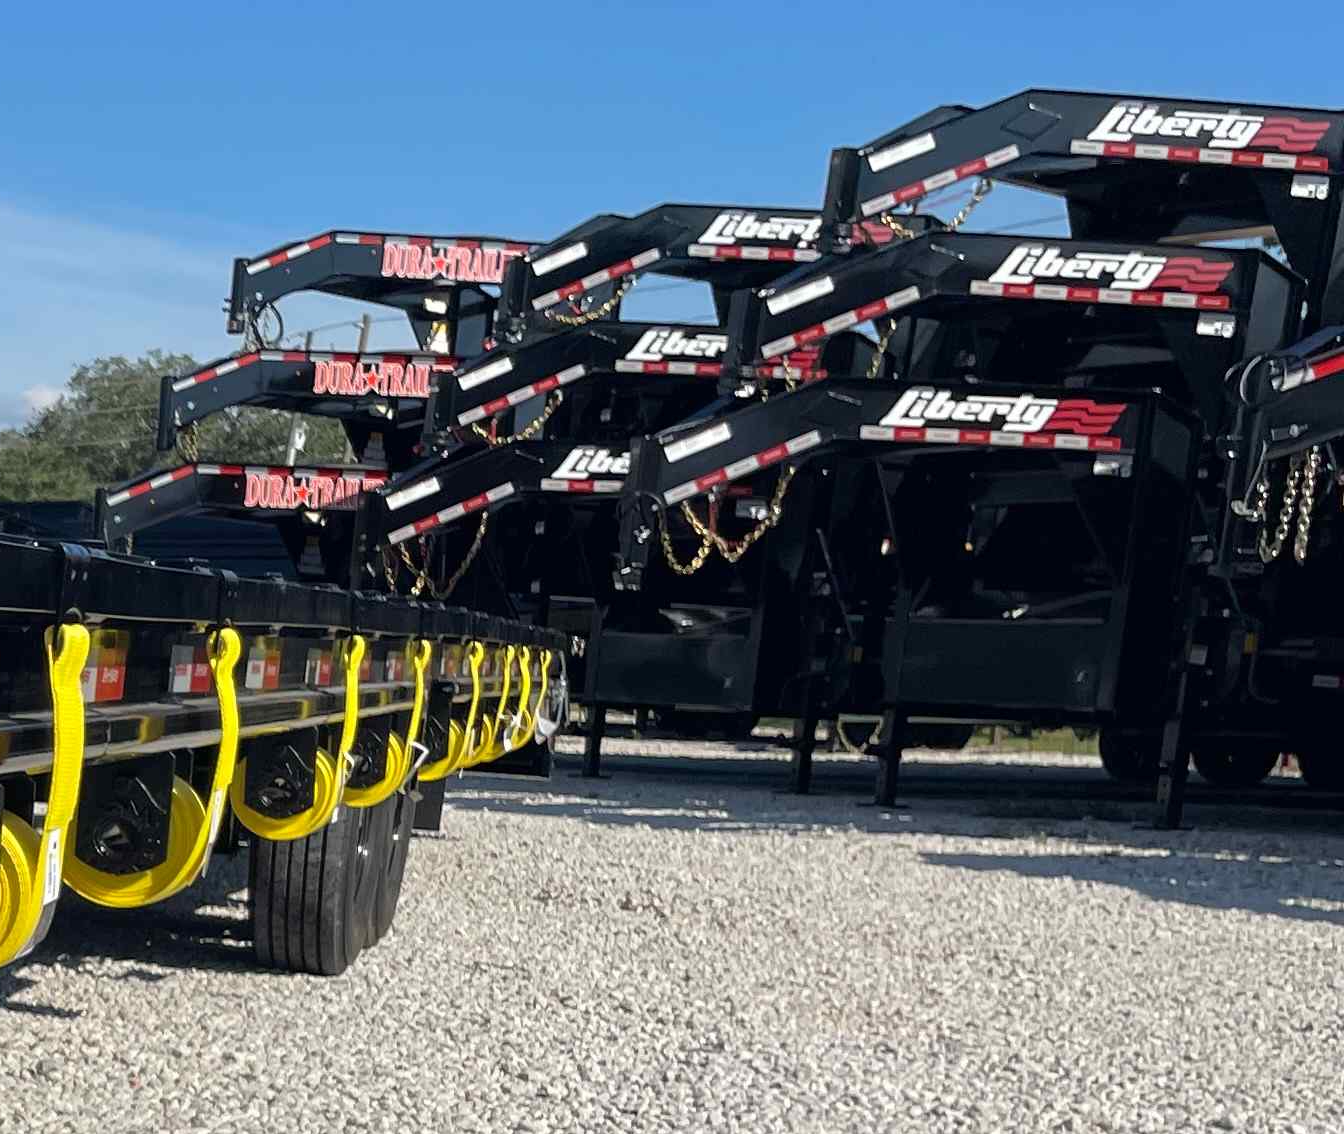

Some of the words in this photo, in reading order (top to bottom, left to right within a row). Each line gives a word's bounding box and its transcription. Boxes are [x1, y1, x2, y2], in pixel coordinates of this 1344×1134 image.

[1087, 102, 1264, 149] Liberty
[698, 209, 823, 248] Libert
[381, 241, 433, 280] DURA
[988, 244, 1167, 290] Liberty
[625, 326, 730, 362] Liber
[313, 360, 366, 395] DURA
[878, 386, 1059, 432] Liberty
[551, 445, 631, 480] Libe
[243, 474, 297, 509] DURA
